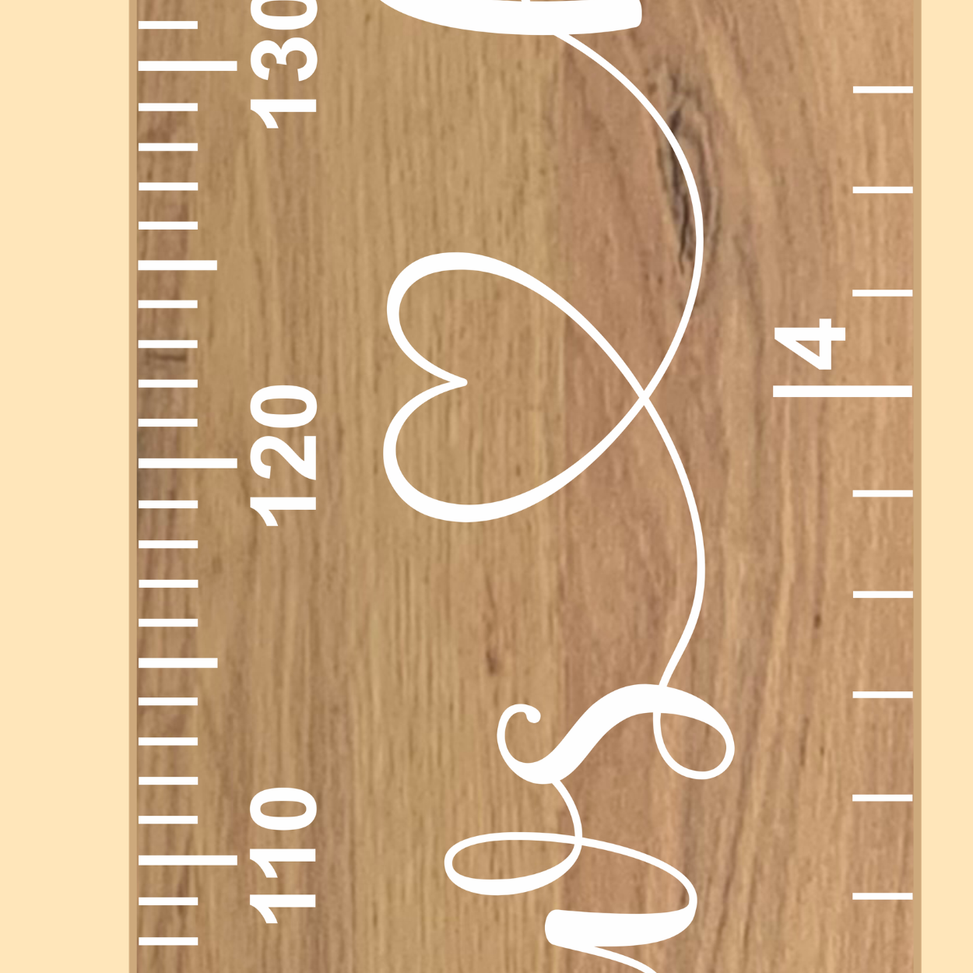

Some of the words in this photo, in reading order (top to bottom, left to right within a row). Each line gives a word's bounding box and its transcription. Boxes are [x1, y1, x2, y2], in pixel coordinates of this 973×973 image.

[250, 0, 318, 129] 130
[773, 318, 846, 370] 4
[250, 385, 318, 527] 120
[249, 787, 317, 924] 110
